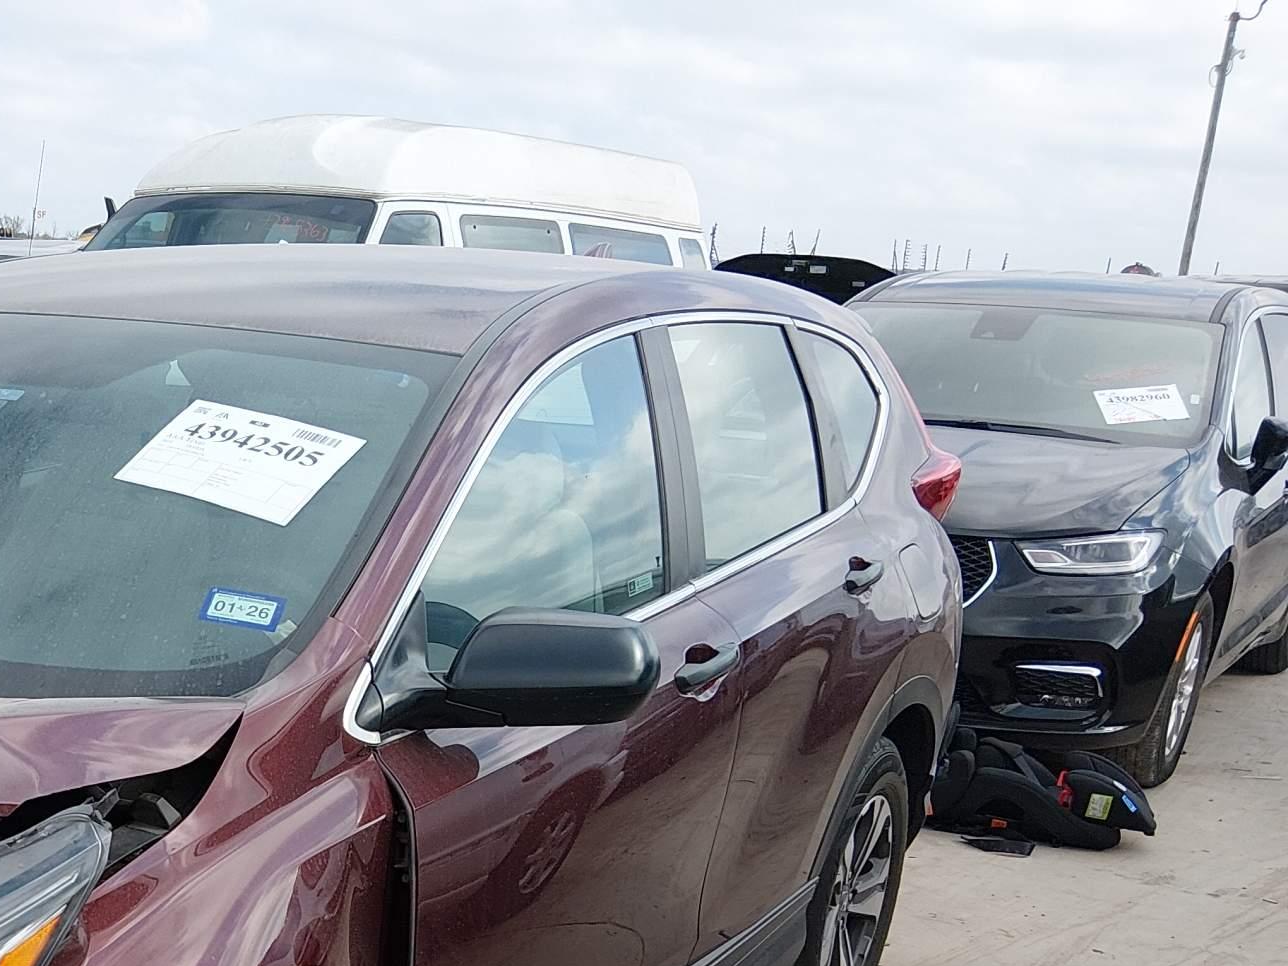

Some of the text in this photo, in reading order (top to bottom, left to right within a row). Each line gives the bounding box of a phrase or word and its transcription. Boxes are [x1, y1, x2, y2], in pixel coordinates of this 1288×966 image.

[184, 422, 325, 467] 43942505
[213, 600, 271, 619] 01 26
